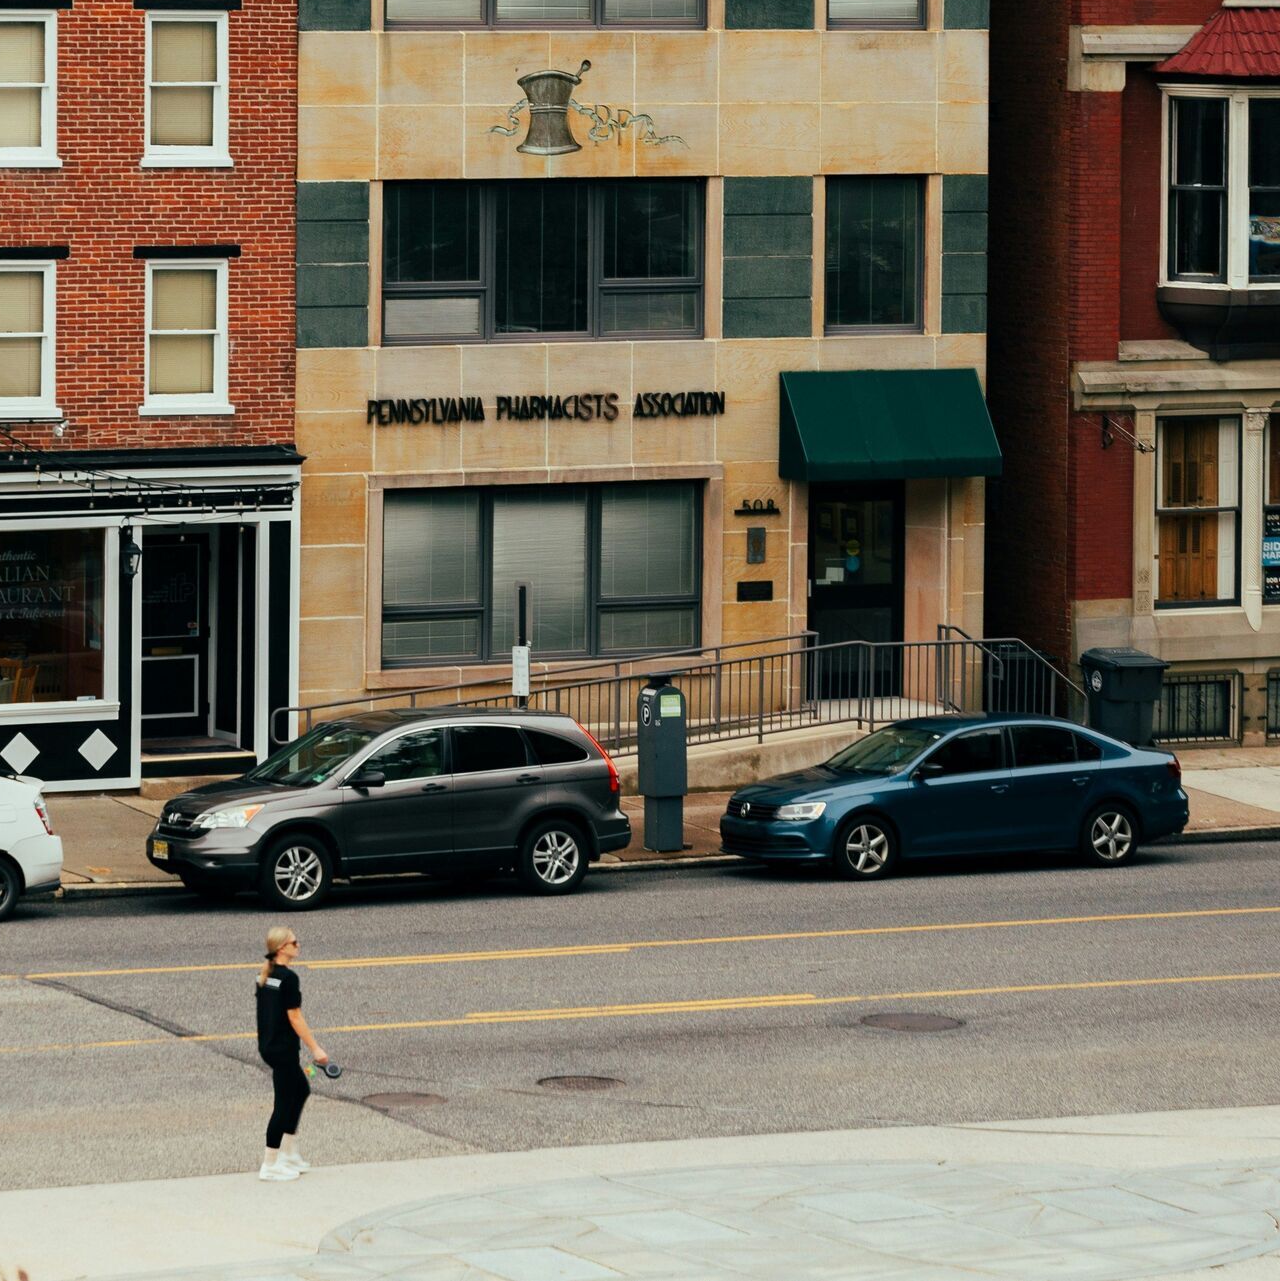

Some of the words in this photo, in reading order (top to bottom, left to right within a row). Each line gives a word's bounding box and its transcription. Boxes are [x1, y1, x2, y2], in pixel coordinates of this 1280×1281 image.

[367, 397, 485, 425] PENNSYLVANIA
[496, 392, 619, 421] PHARMACISTS
[633, 391, 725, 418] ASSOCIATION
